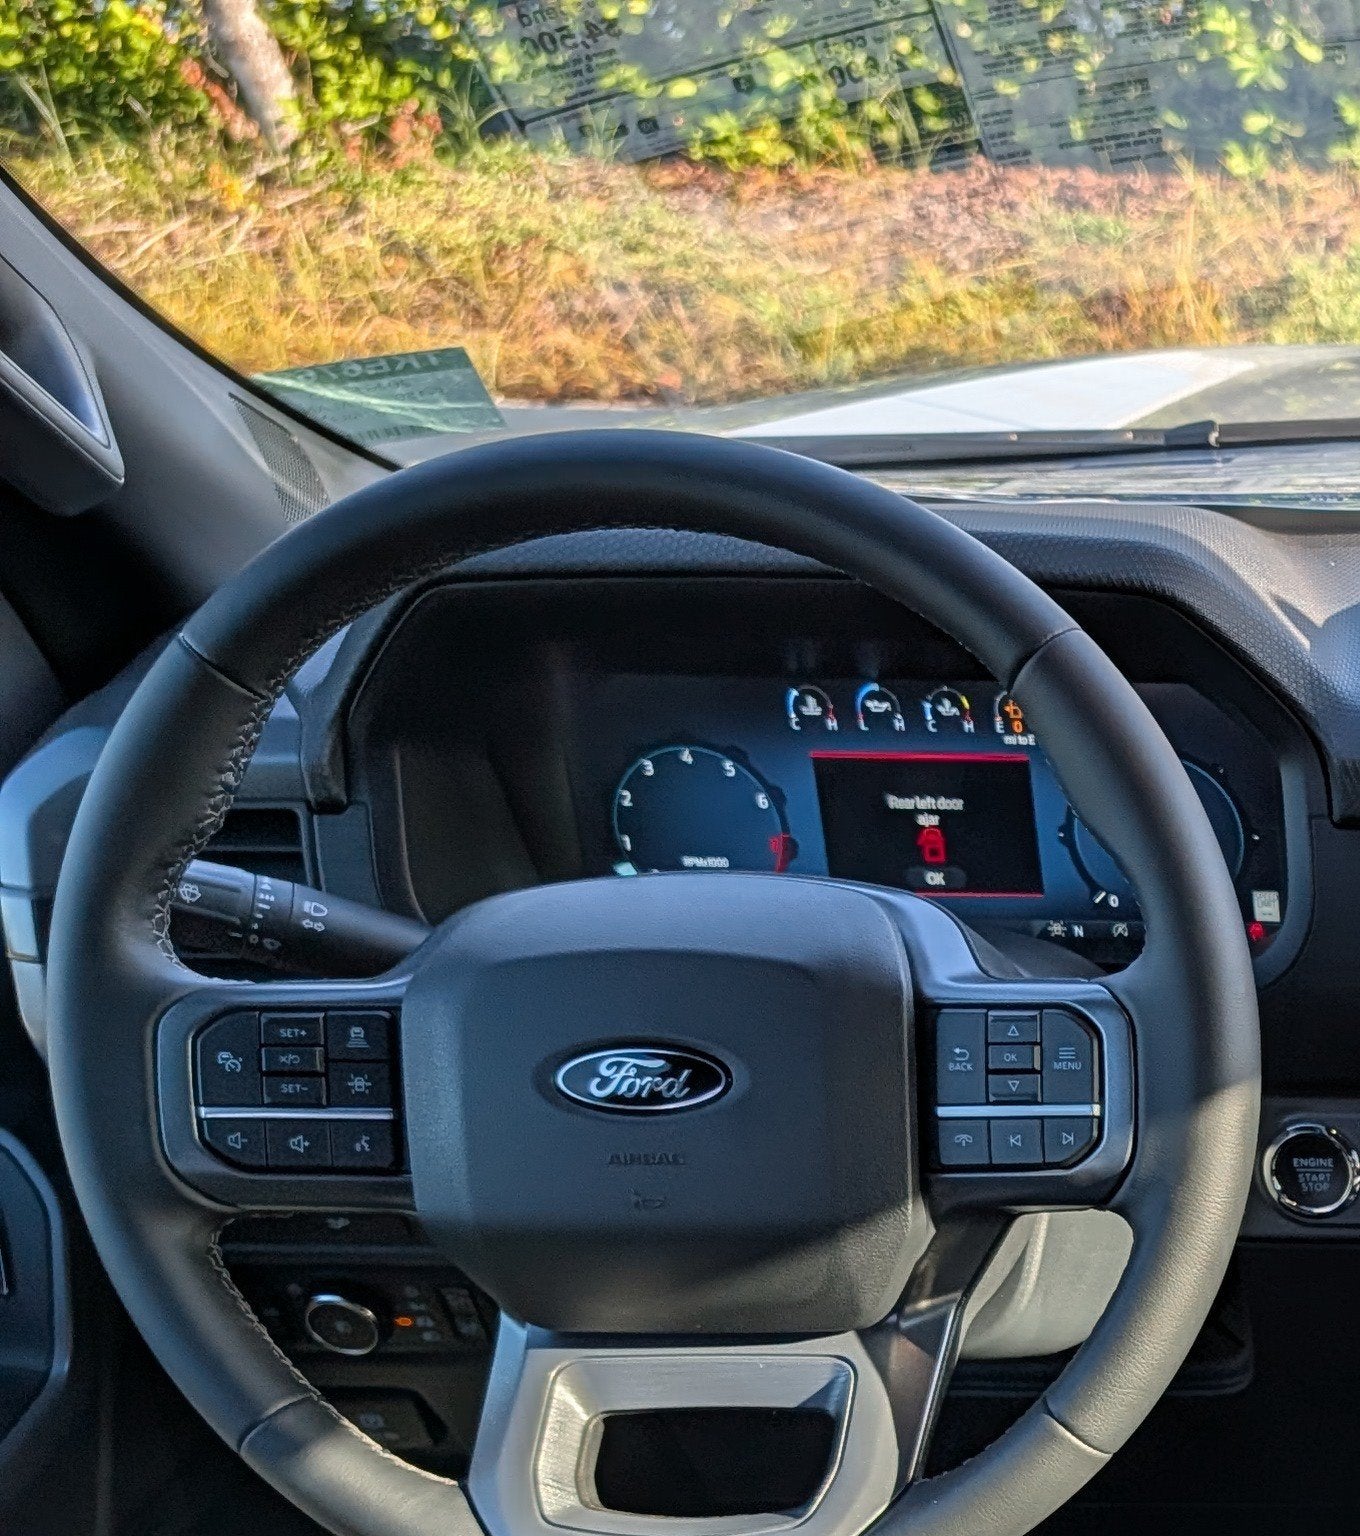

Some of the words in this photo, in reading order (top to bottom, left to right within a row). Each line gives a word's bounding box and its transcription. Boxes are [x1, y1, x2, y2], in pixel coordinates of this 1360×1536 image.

[643, 758, 655, 776] 3
[722, 759, 736, 777] 5
[619, 789, 633, 807] 2
[755, 792, 769, 809] 6
[924, 871, 945, 885] OK
[1073, 925, 1084, 937] N
[1003, 1053, 1017, 1062] OK
[949, 1063, 973, 1071] BACK
[1053, 1062, 1082, 1070] MENU
[589, 1056, 693, 1098] Ford
[1293, 1157, 1334, 1168] ENGINE
[1299, 1173, 1331, 1182] START
[1301, 1182, 1330, 1192] STOP
